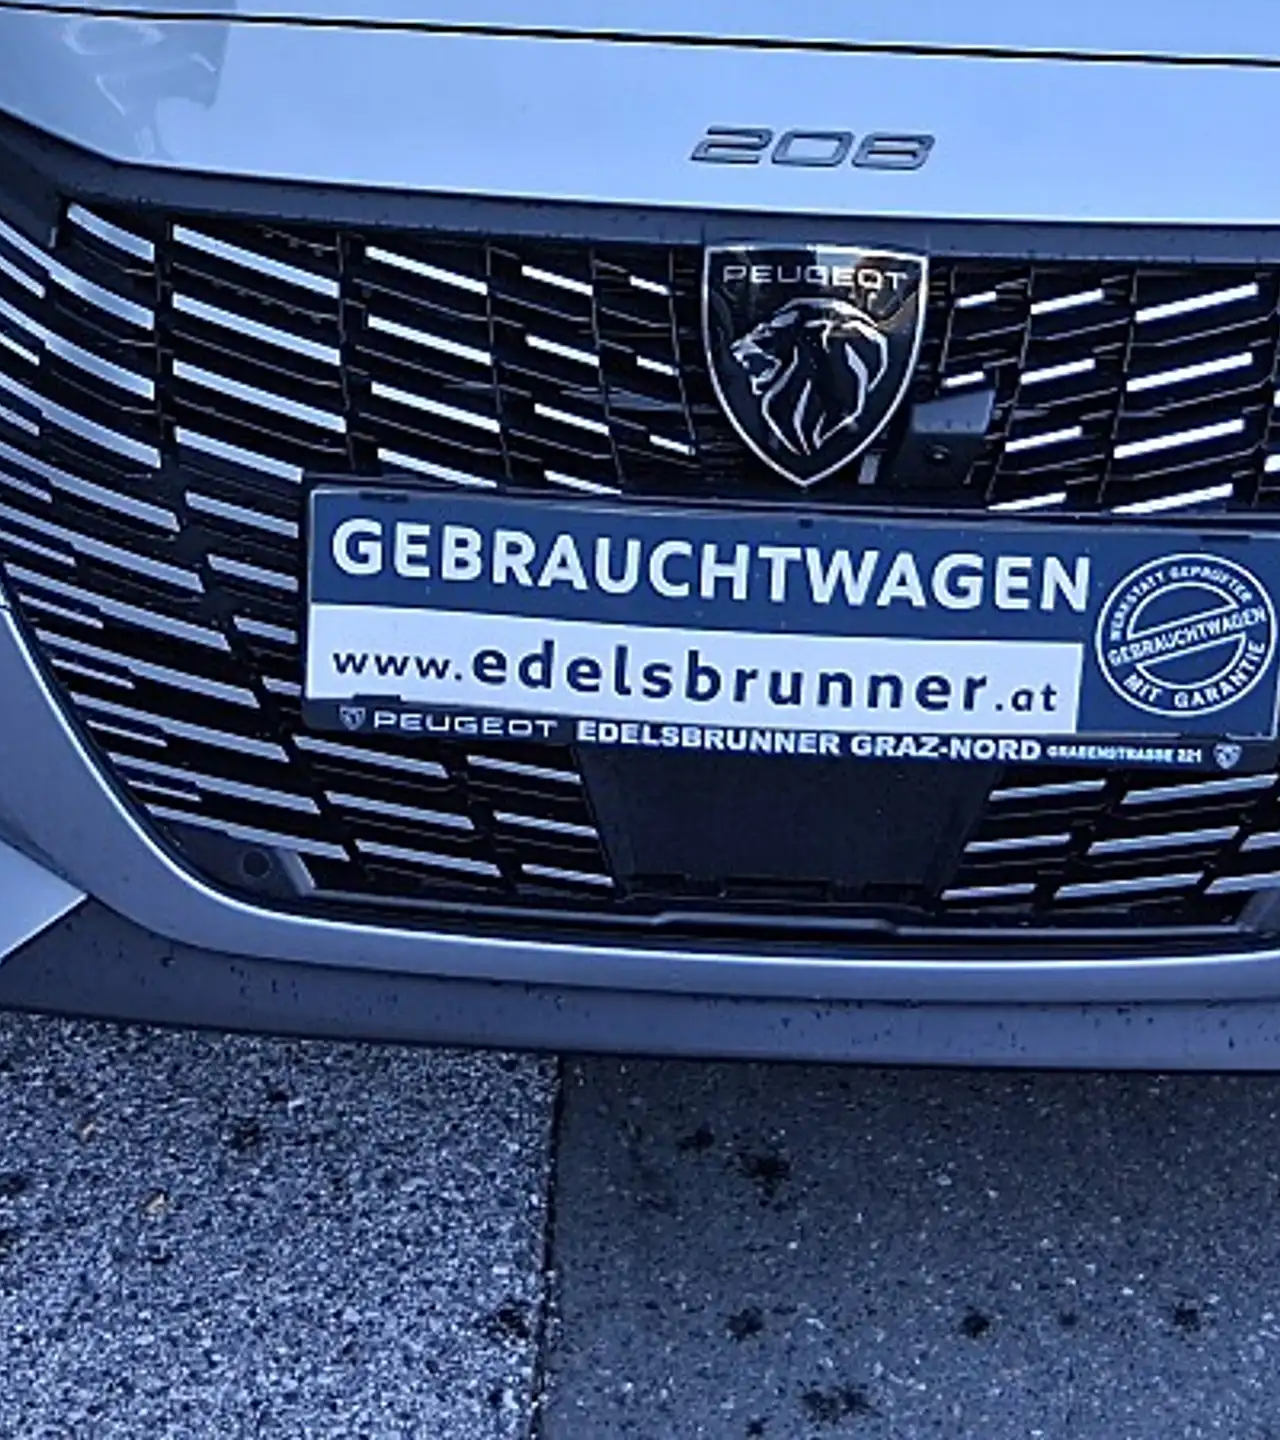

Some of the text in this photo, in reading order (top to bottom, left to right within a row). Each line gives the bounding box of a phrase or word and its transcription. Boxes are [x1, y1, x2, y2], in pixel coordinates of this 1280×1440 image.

[690, 125, 936, 171] 208
[722, 264, 907, 290] PEUGEOT
[331, 516, 1091, 613] GEBRAUCHTWAGEN
[1107, 605, 1267, 667] GEBRAUCHTWAGEN
[332, 639, 1059, 713] www.edelsbrunner.at
[1122, 640, 1266, 709] MIT GARANTIE
[373, 711, 559, 738] PEUGEOT
[577, 719, 840, 756] EDELSBRUNNER
[850, 735, 1042, 760] GRAZ-NORD
